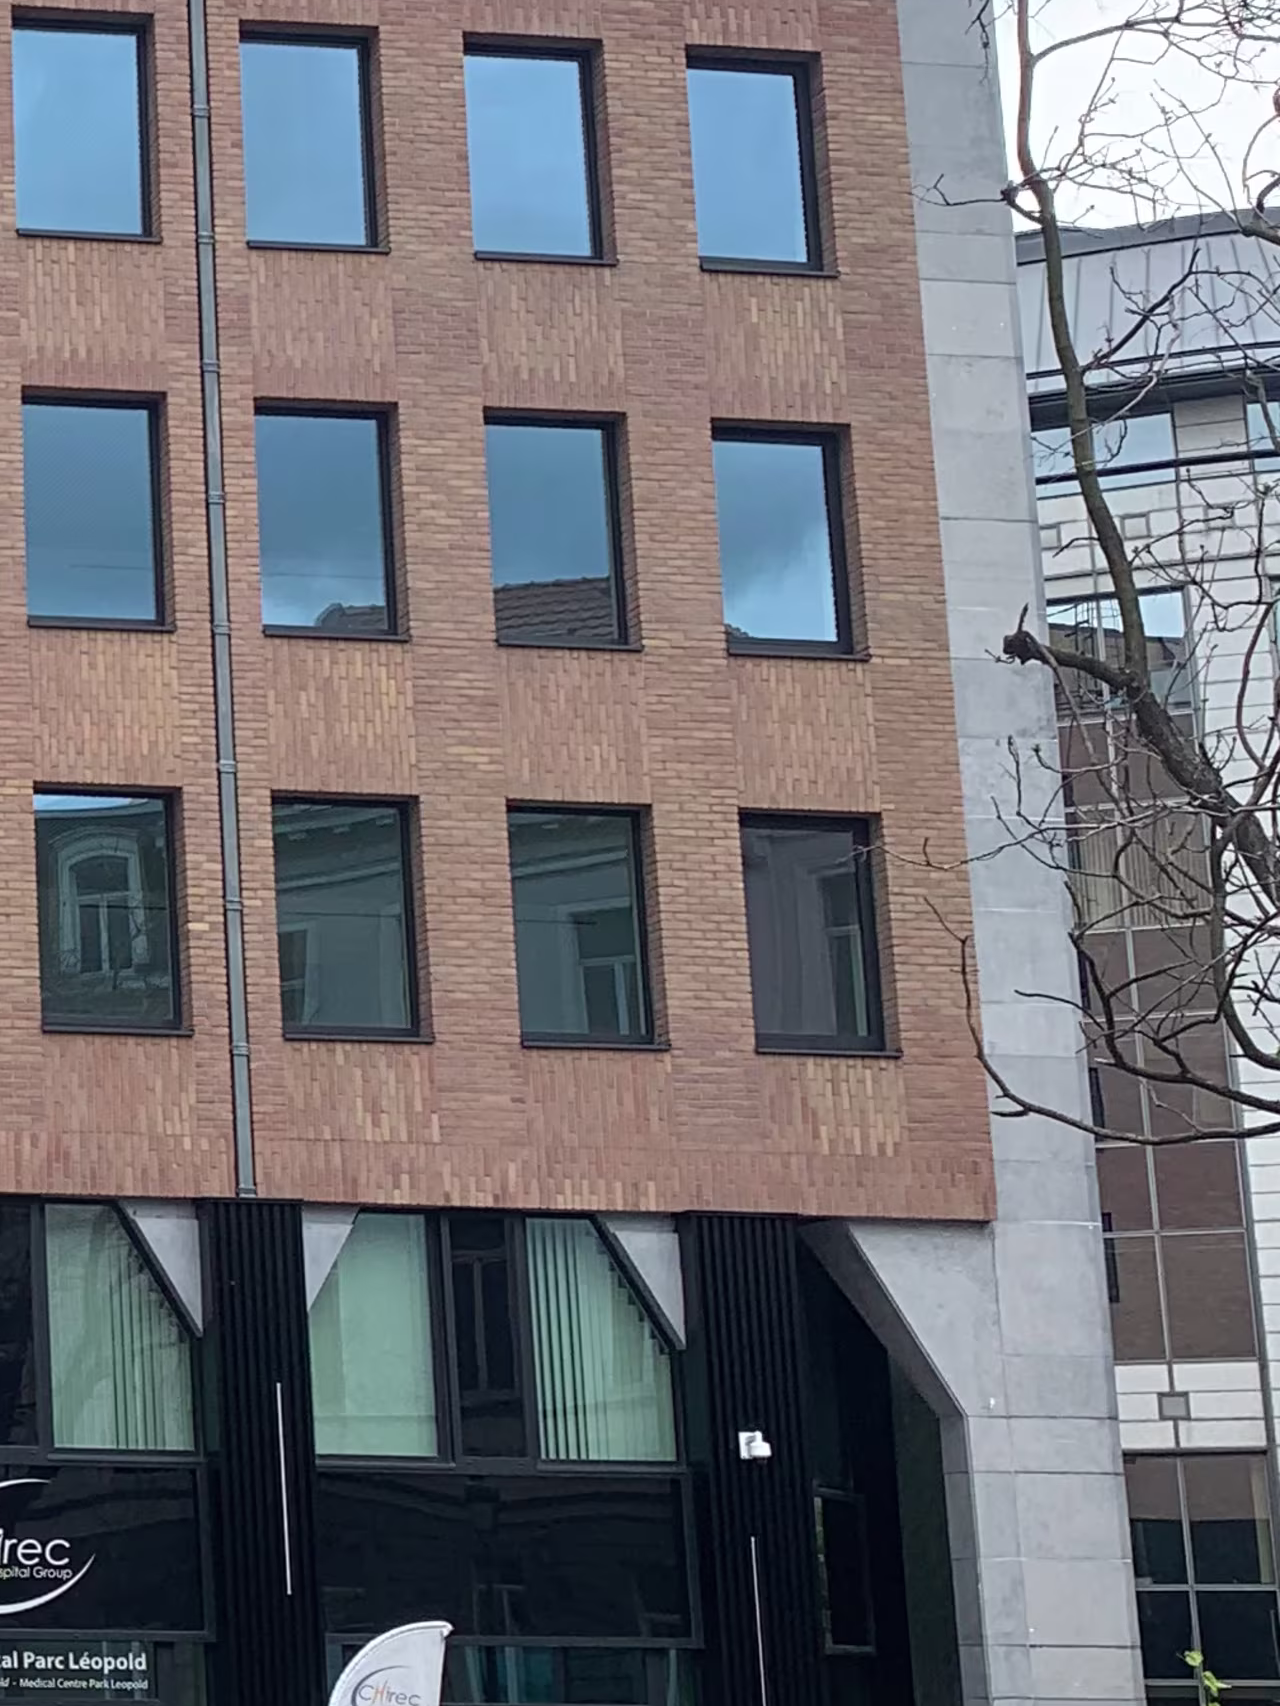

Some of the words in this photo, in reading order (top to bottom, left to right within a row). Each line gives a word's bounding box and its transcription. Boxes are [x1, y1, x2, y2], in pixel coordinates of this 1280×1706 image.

[32, 1565, 73, 1580] Group
[22, 1651, 65, 1669] Parc
[68, 1651, 147, 1674] Léopold
[19, 1678, 56, 1689] Medical
[57, 1678, 88, 1689] Centre
[89, 1678, 109, 1689] Park
